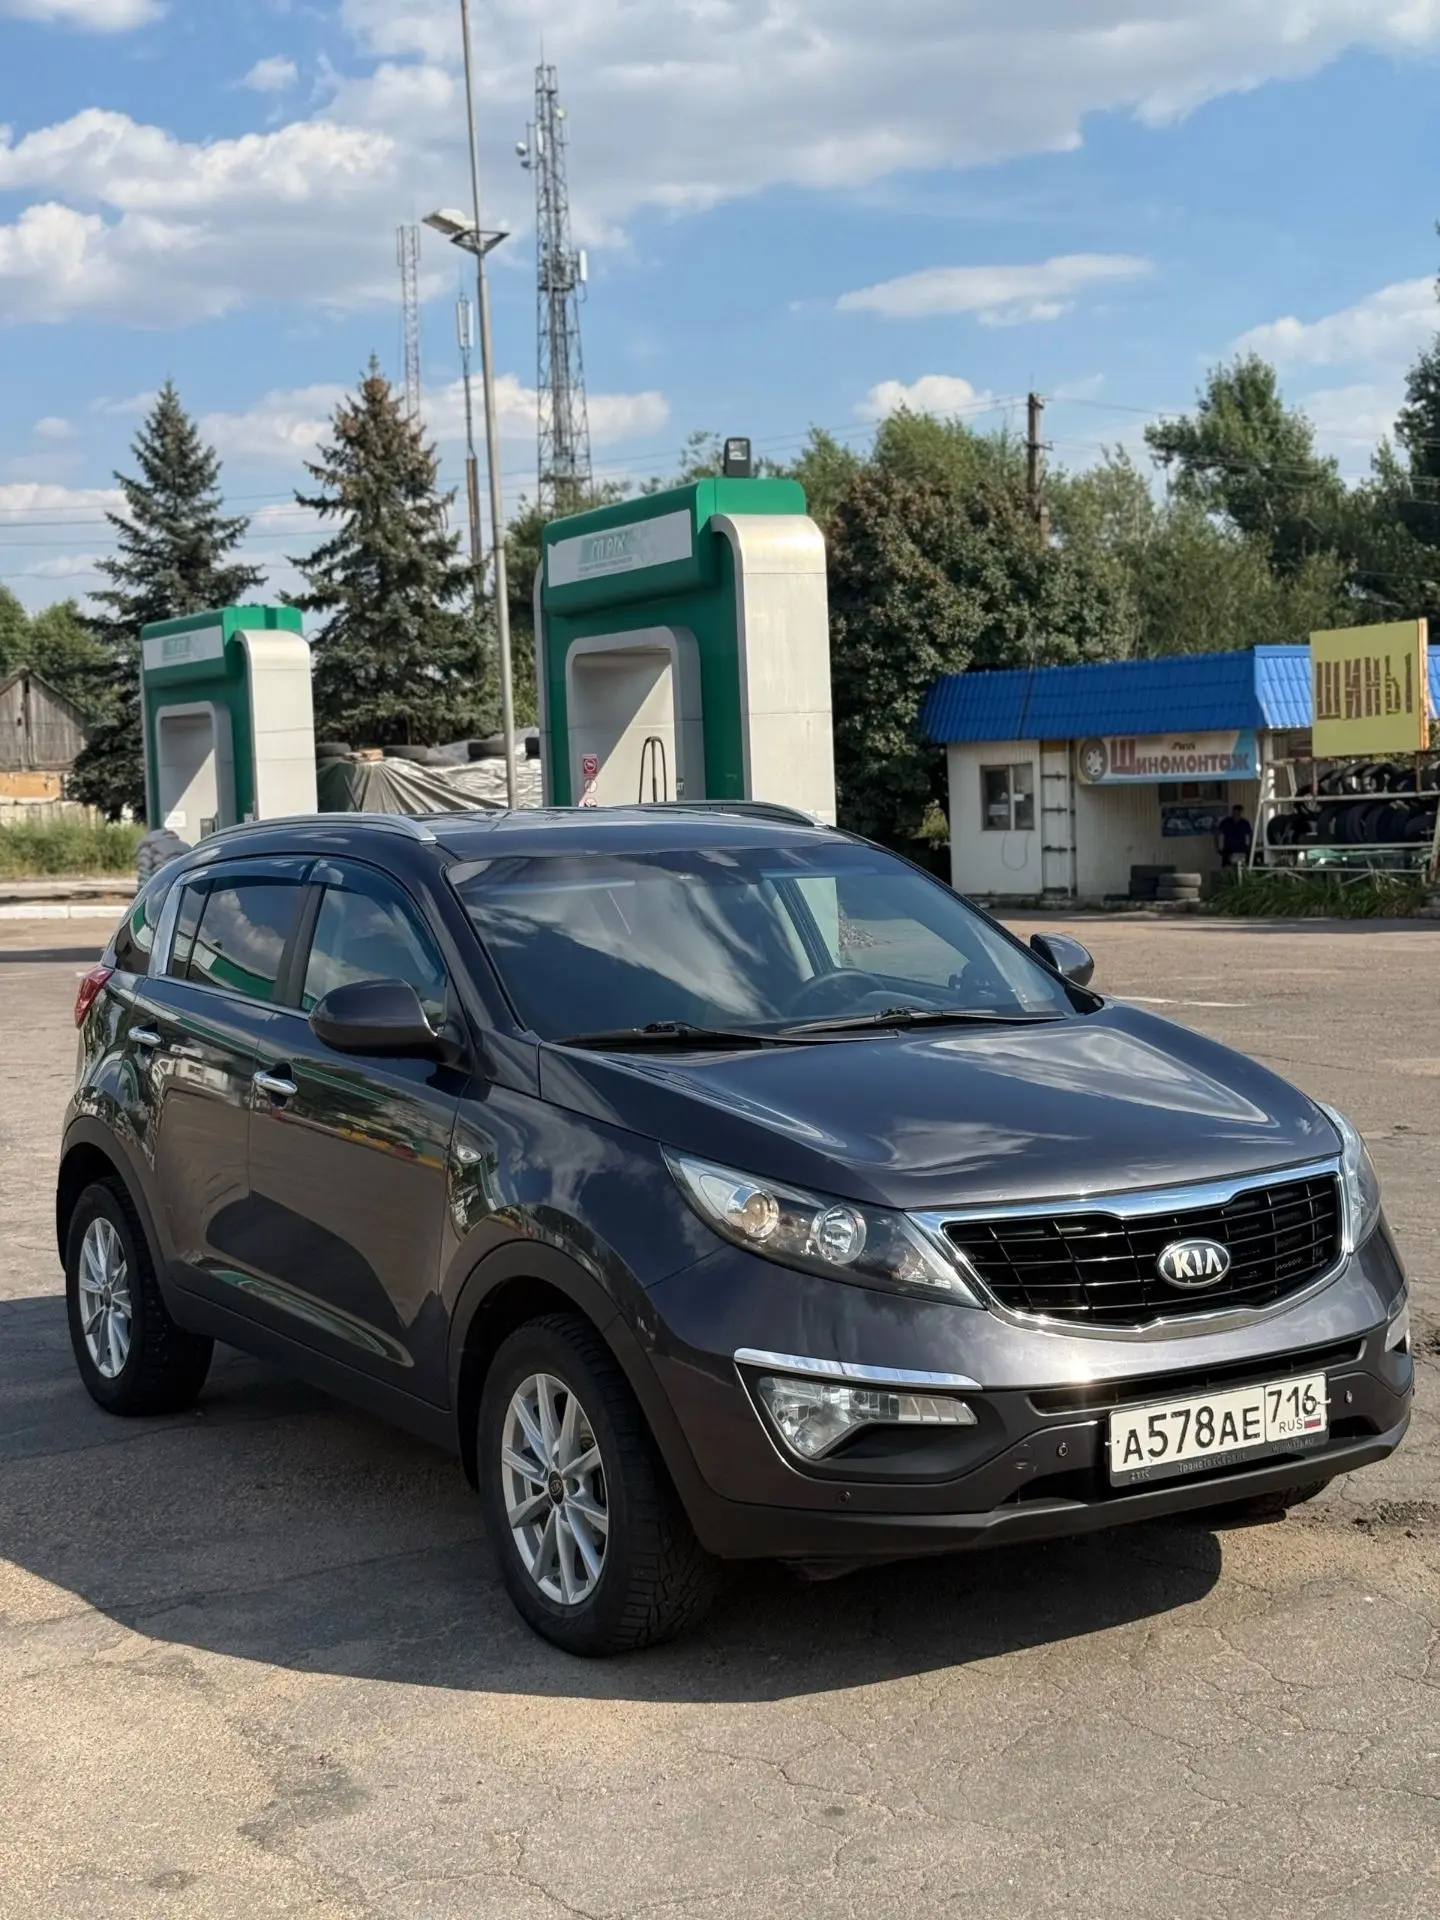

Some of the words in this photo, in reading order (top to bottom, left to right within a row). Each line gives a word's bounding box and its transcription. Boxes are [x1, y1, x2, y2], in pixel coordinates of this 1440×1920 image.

[1316, 653, 1412, 720] ШИНЫ
[1171, 1248, 1222, 1278] KIA
[1267, 1383, 1316, 1423] 716
[1279, 1418, 1303, 1433] RUS
